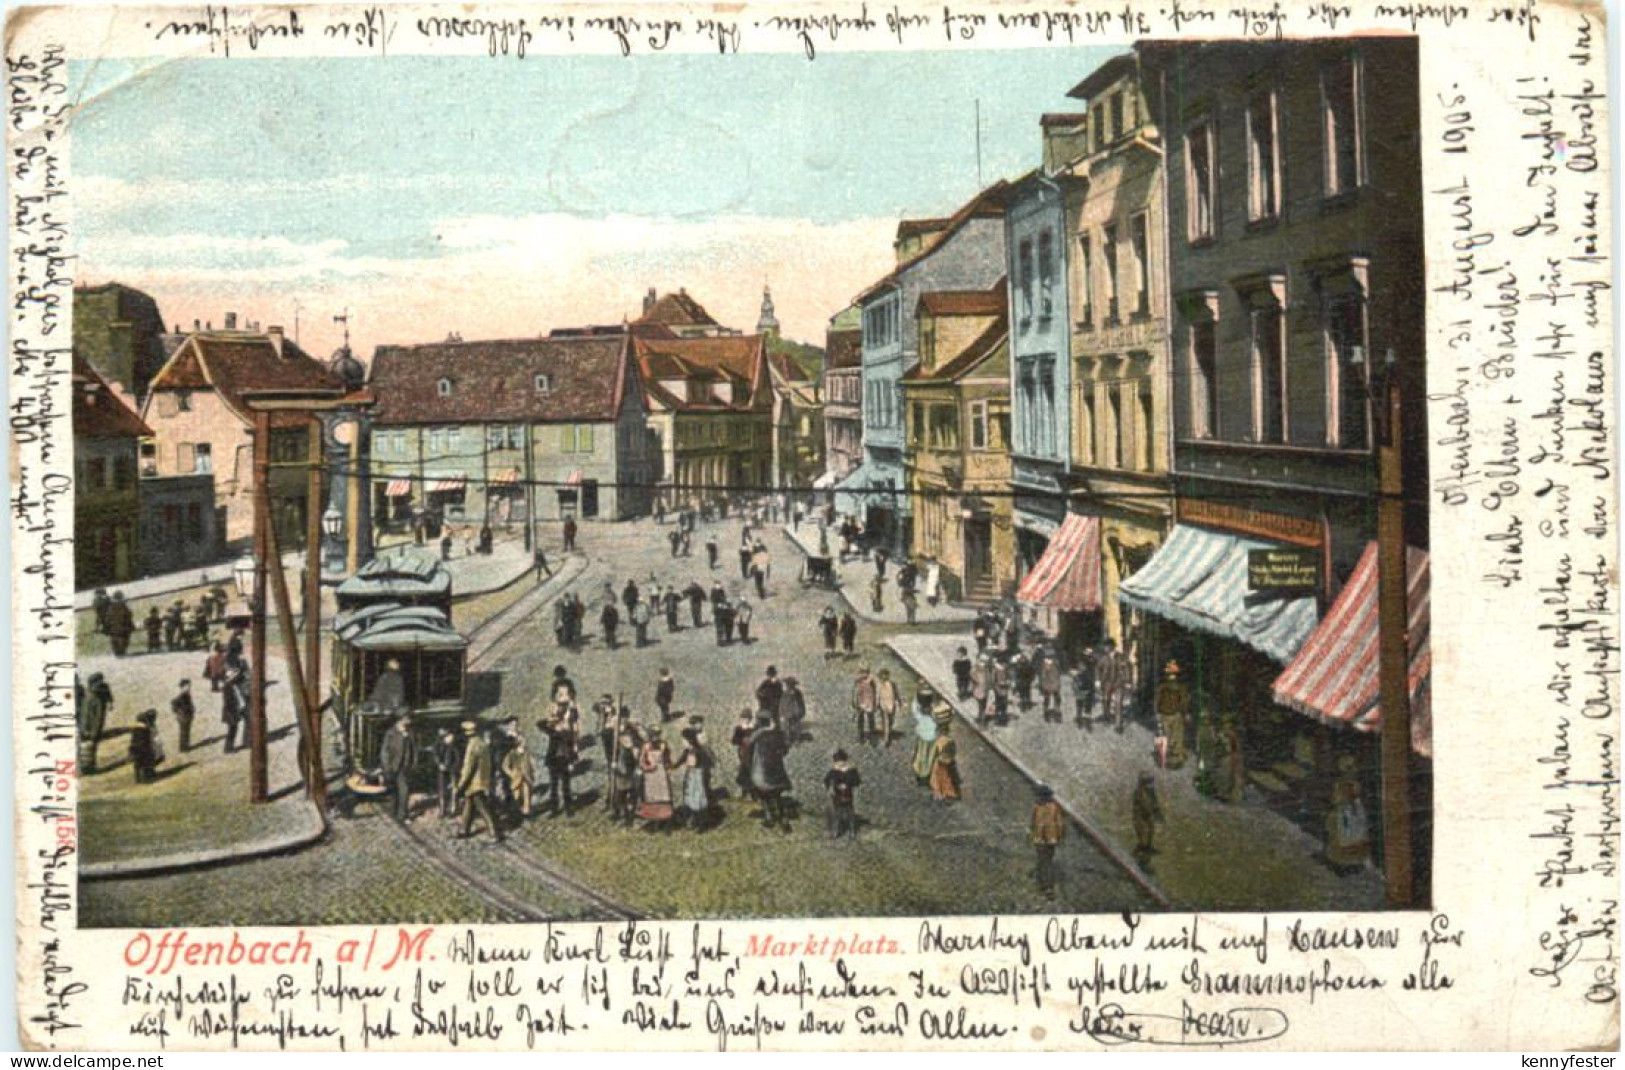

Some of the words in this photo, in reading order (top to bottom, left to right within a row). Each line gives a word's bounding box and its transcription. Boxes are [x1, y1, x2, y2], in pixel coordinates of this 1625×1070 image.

[539, 17, 574, 41] in
[696, 20, 740, 54] Wir
[1307, 3, 1351, 30] wir
[43, 156, 68, 202] mit
[1513, 185, 1557, 236] den
[1432, 176, 1493, 300] August
[1525, 258, 1575, 305] für
[1482, 418, 1520, 510] Eltern
[1534, 478, 1570, 538] und
[1547, 660, 1572, 706] wir
[55, 760, 76, 798] No.
[123, 930, 312, 974] Offenbach
[747, 935, 904, 962] Marktplatz.
[1144, 915, 1207, 953] mit
[468, 968, 522, 1002] soll
[537, 974, 564, 995] er
